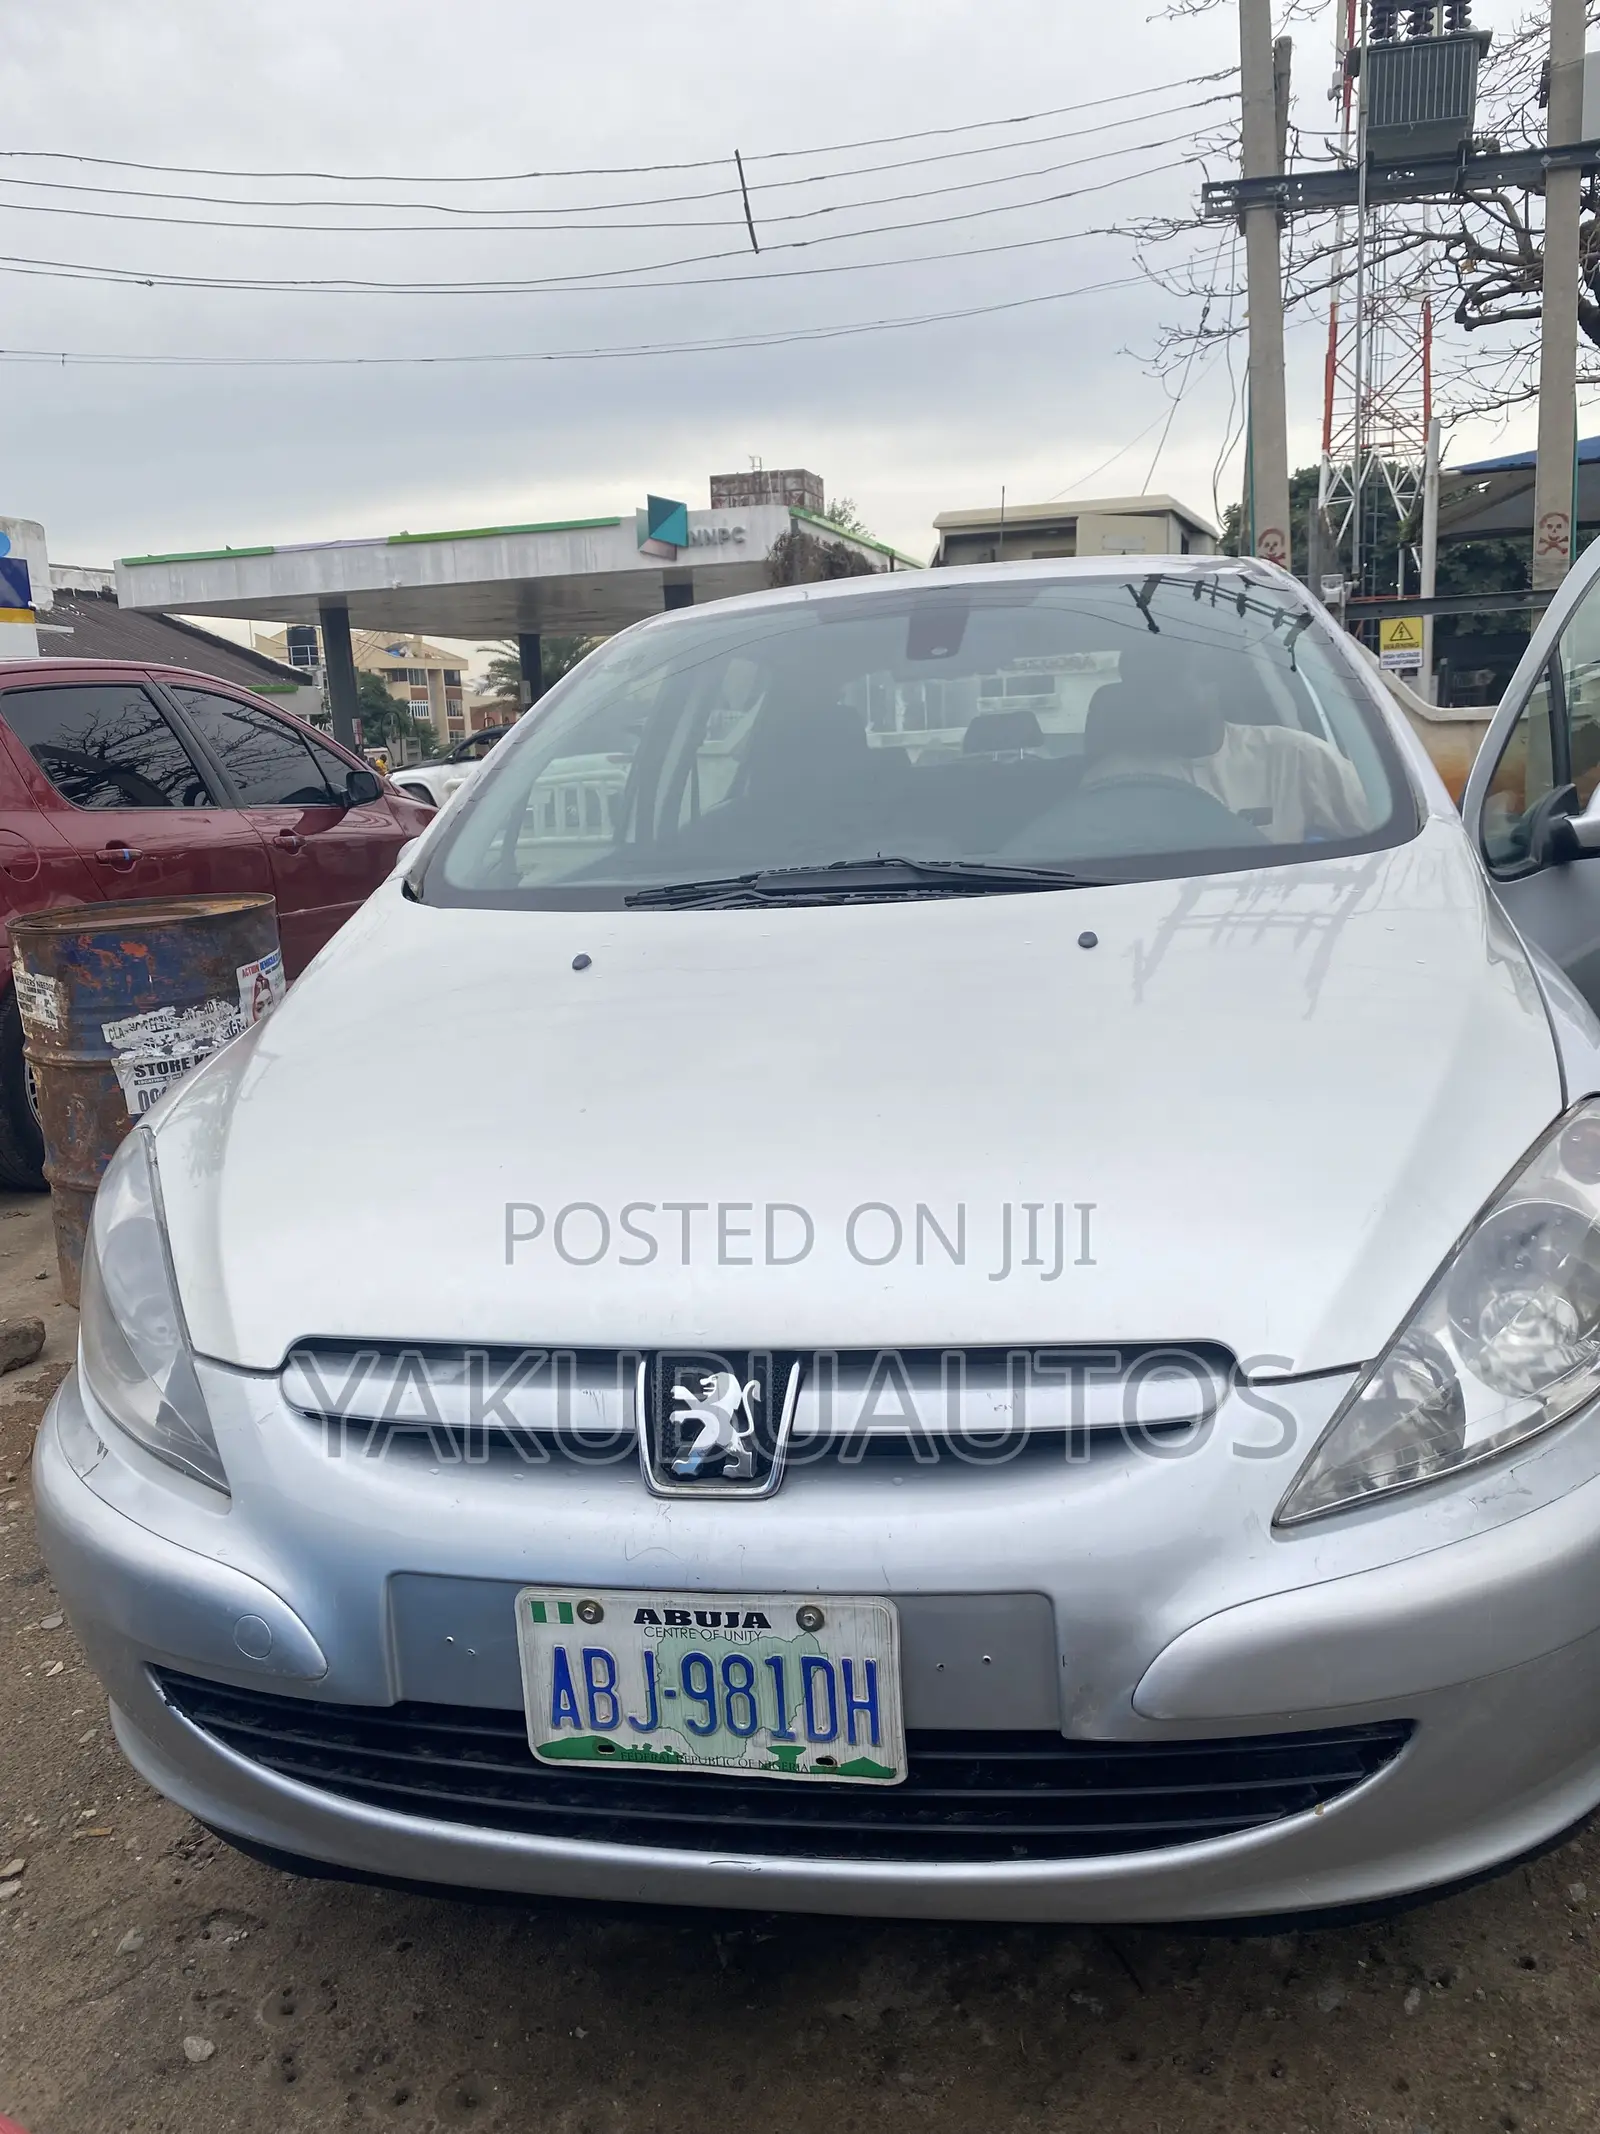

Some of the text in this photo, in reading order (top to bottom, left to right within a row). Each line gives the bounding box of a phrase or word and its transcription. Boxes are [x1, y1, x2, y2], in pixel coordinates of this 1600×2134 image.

[689, 526, 746, 547] NNPC
[1383, 642, 1419, 650] WARNING
[134, 1057, 190, 1078] STORE
[634, 1609, 771, 1628] ABUJA
[644, 1626, 762, 1642] CENTRE OF UNITY
[551, 1646, 882, 1746] ABJ-981DH
[621, 1751, 809, 1773] FEDERAL REPUBLIC OF NIGERIA
